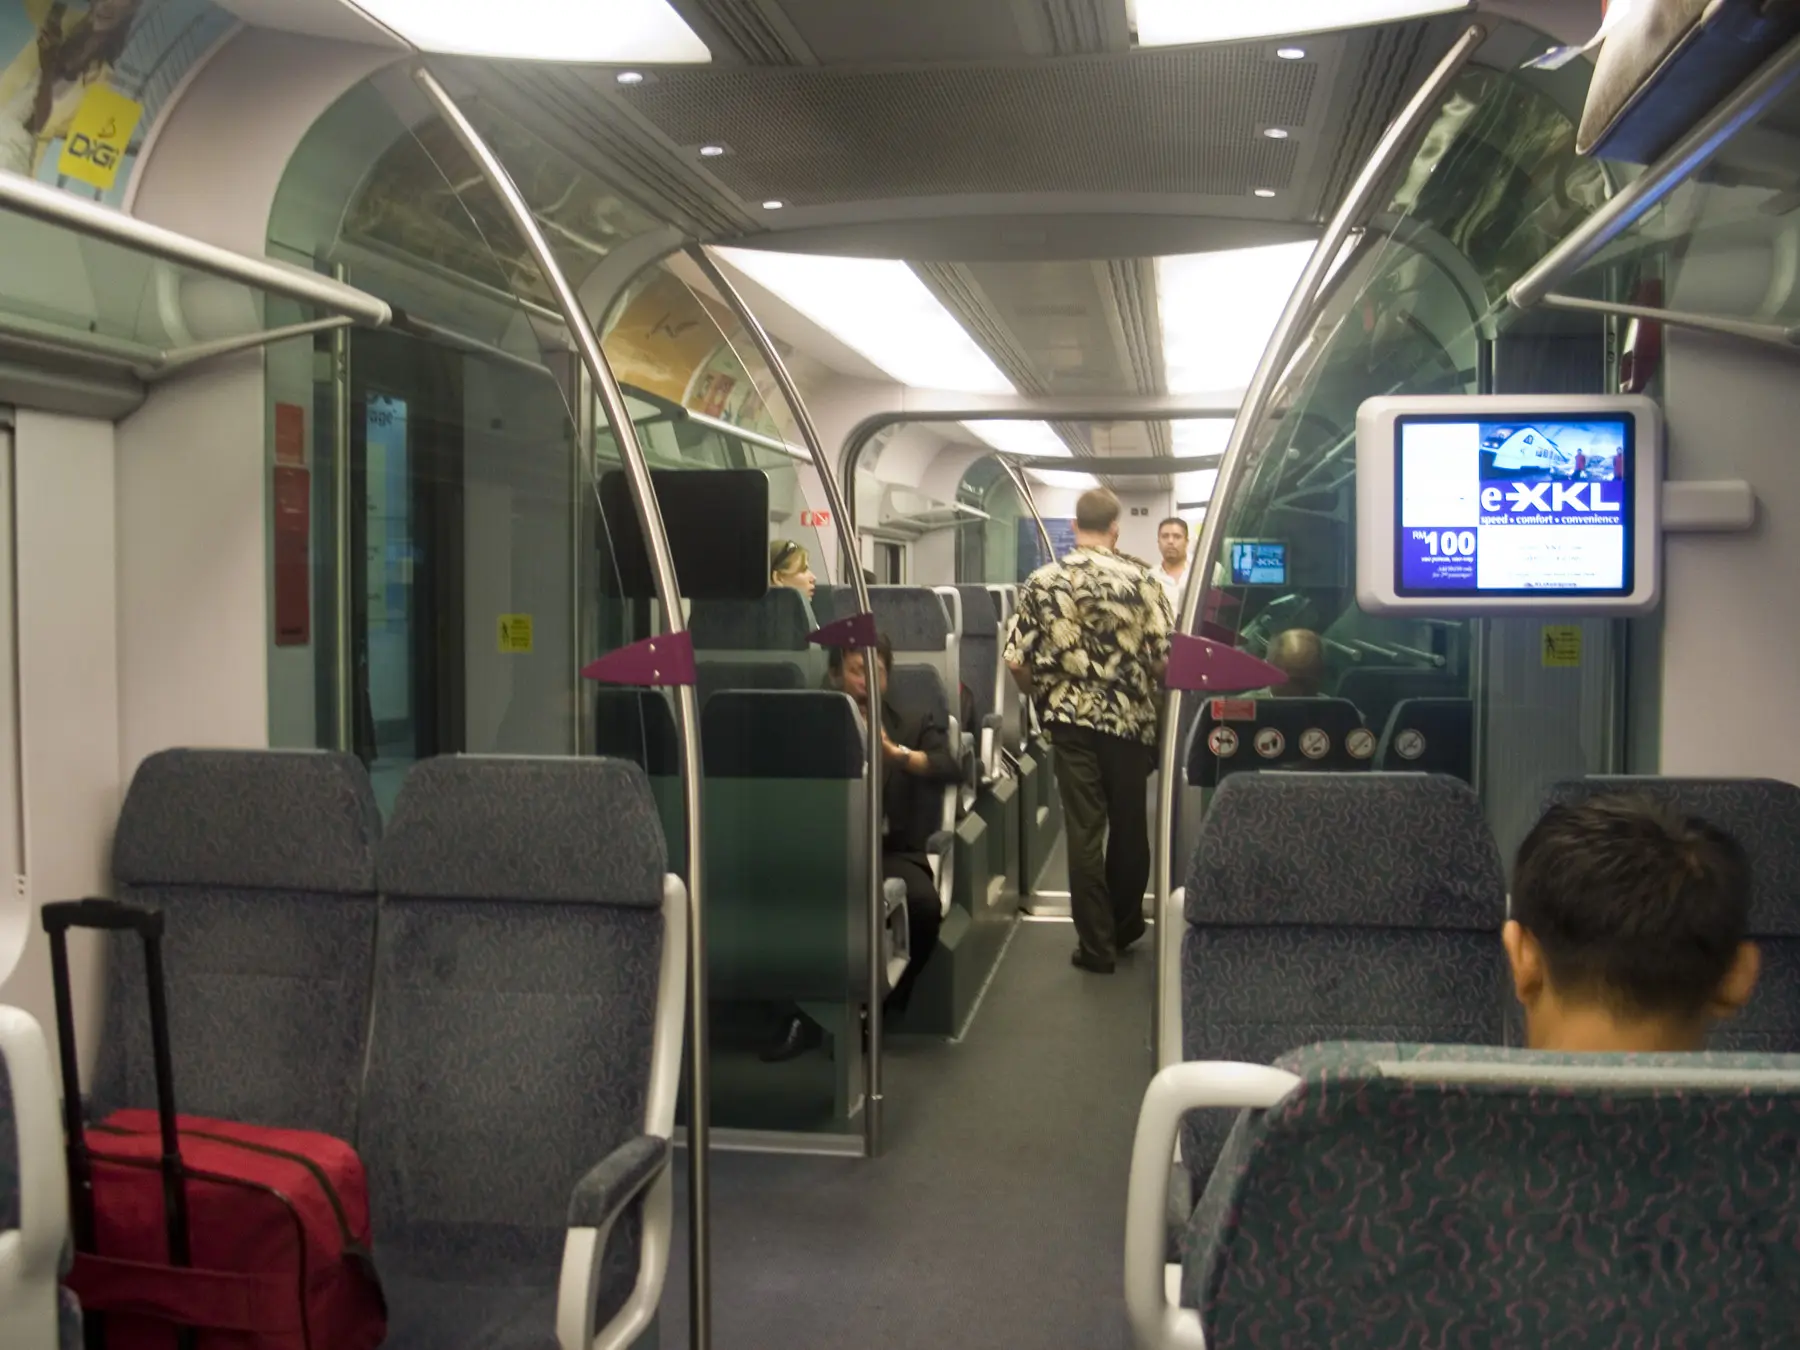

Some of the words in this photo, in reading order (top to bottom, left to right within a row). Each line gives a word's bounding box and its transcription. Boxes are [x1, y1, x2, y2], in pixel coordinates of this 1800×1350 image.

[1480, 481, 1620, 512] e-XKL
[1481, 513, 1508, 525] speed
[1515, 513, 1553, 524] comfort
[1560, 513, 1620, 524] convenience
